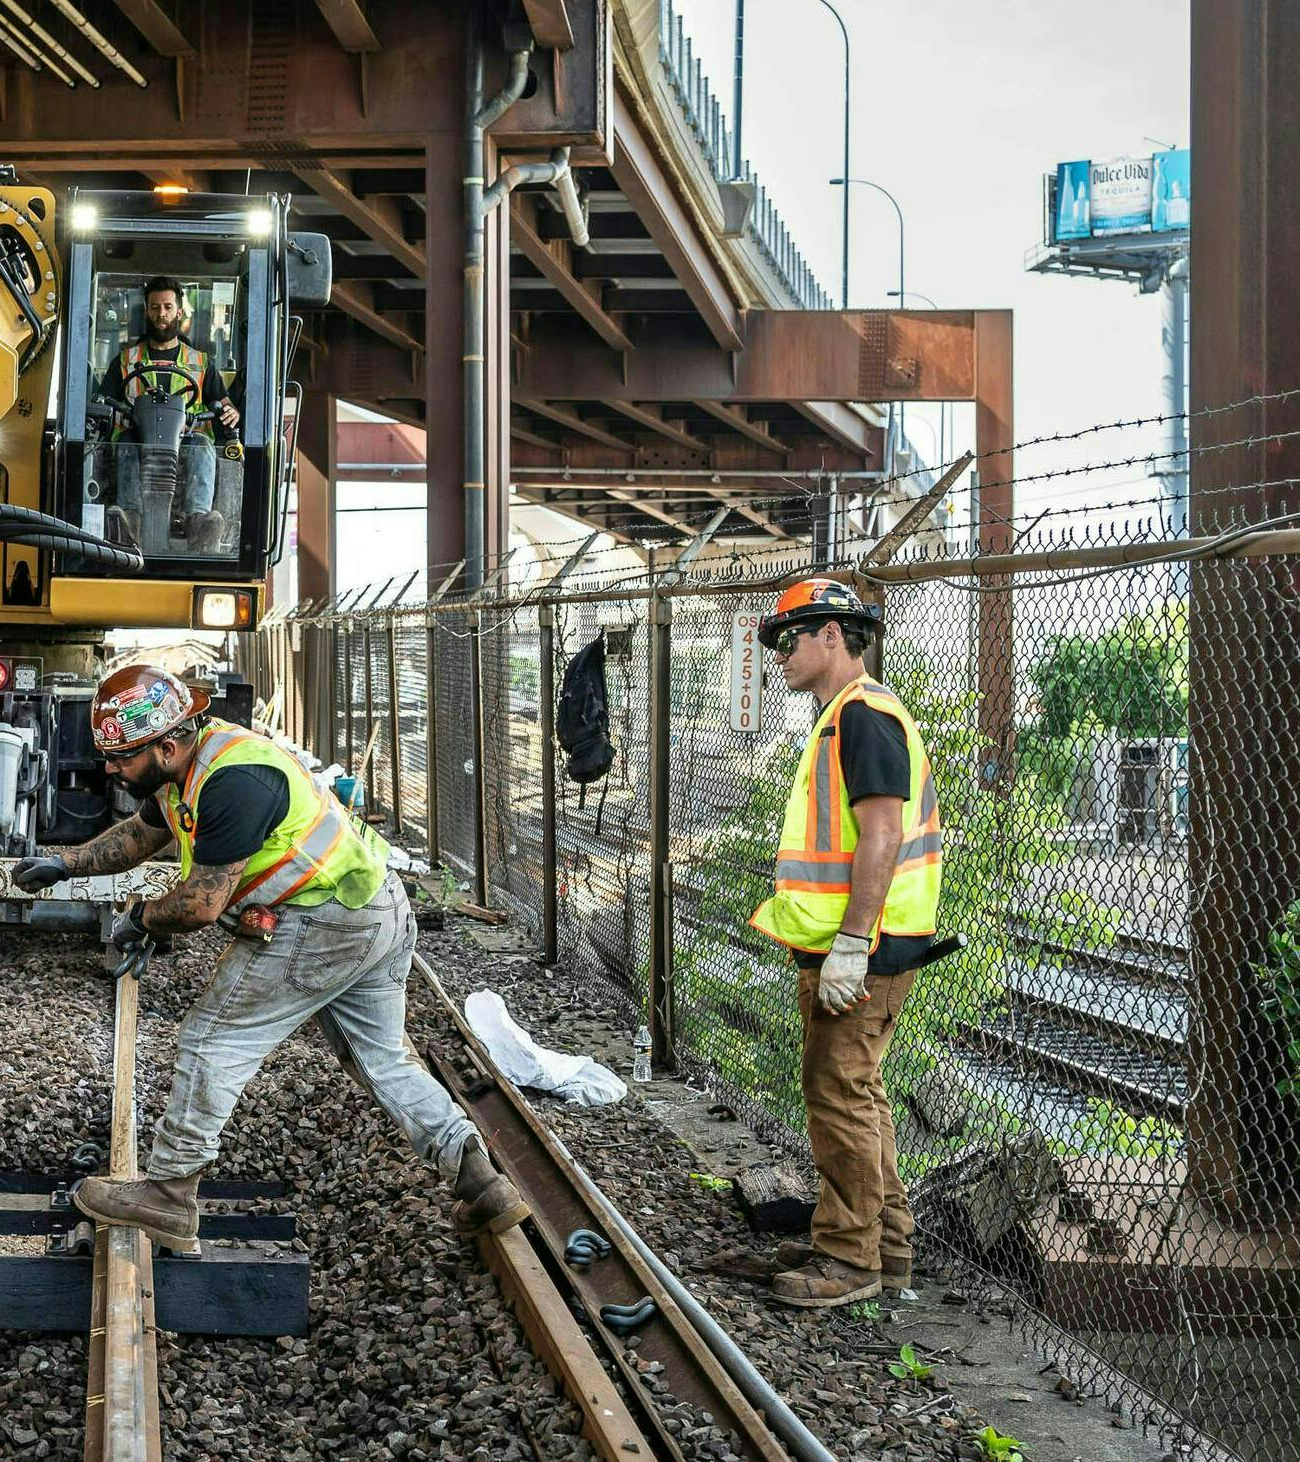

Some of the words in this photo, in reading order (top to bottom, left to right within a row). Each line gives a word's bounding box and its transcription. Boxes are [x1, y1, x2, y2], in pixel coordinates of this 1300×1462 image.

[1124, 165, 1148, 180] Vida
[1100, 186, 1140, 195] TEQUILA
[738, 616, 758, 628] OS
